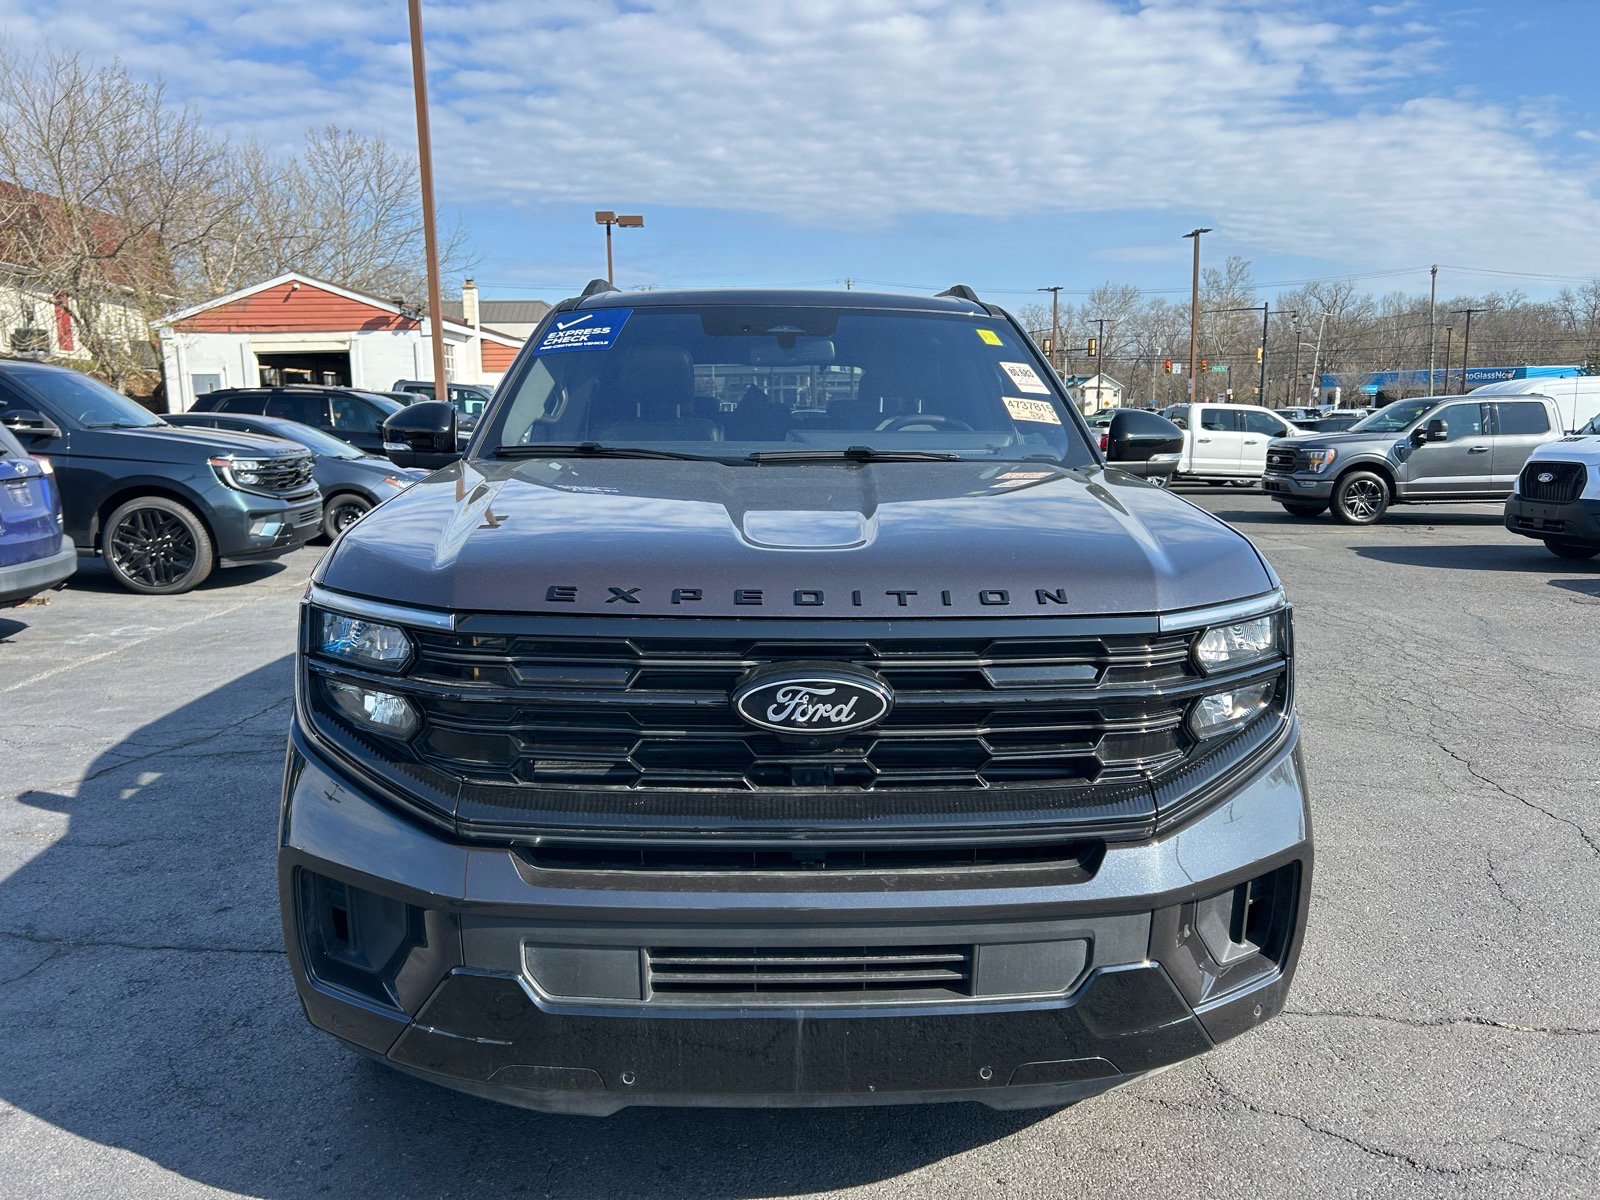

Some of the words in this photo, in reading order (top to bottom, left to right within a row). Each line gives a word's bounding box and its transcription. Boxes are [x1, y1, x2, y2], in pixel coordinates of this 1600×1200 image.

[543, 335, 590, 345] CHECK
[547, 327, 611, 339] EXPRESS
[545, 584, 1069, 605] EXPEDITION
[766, 685, 857, 723] Ford
